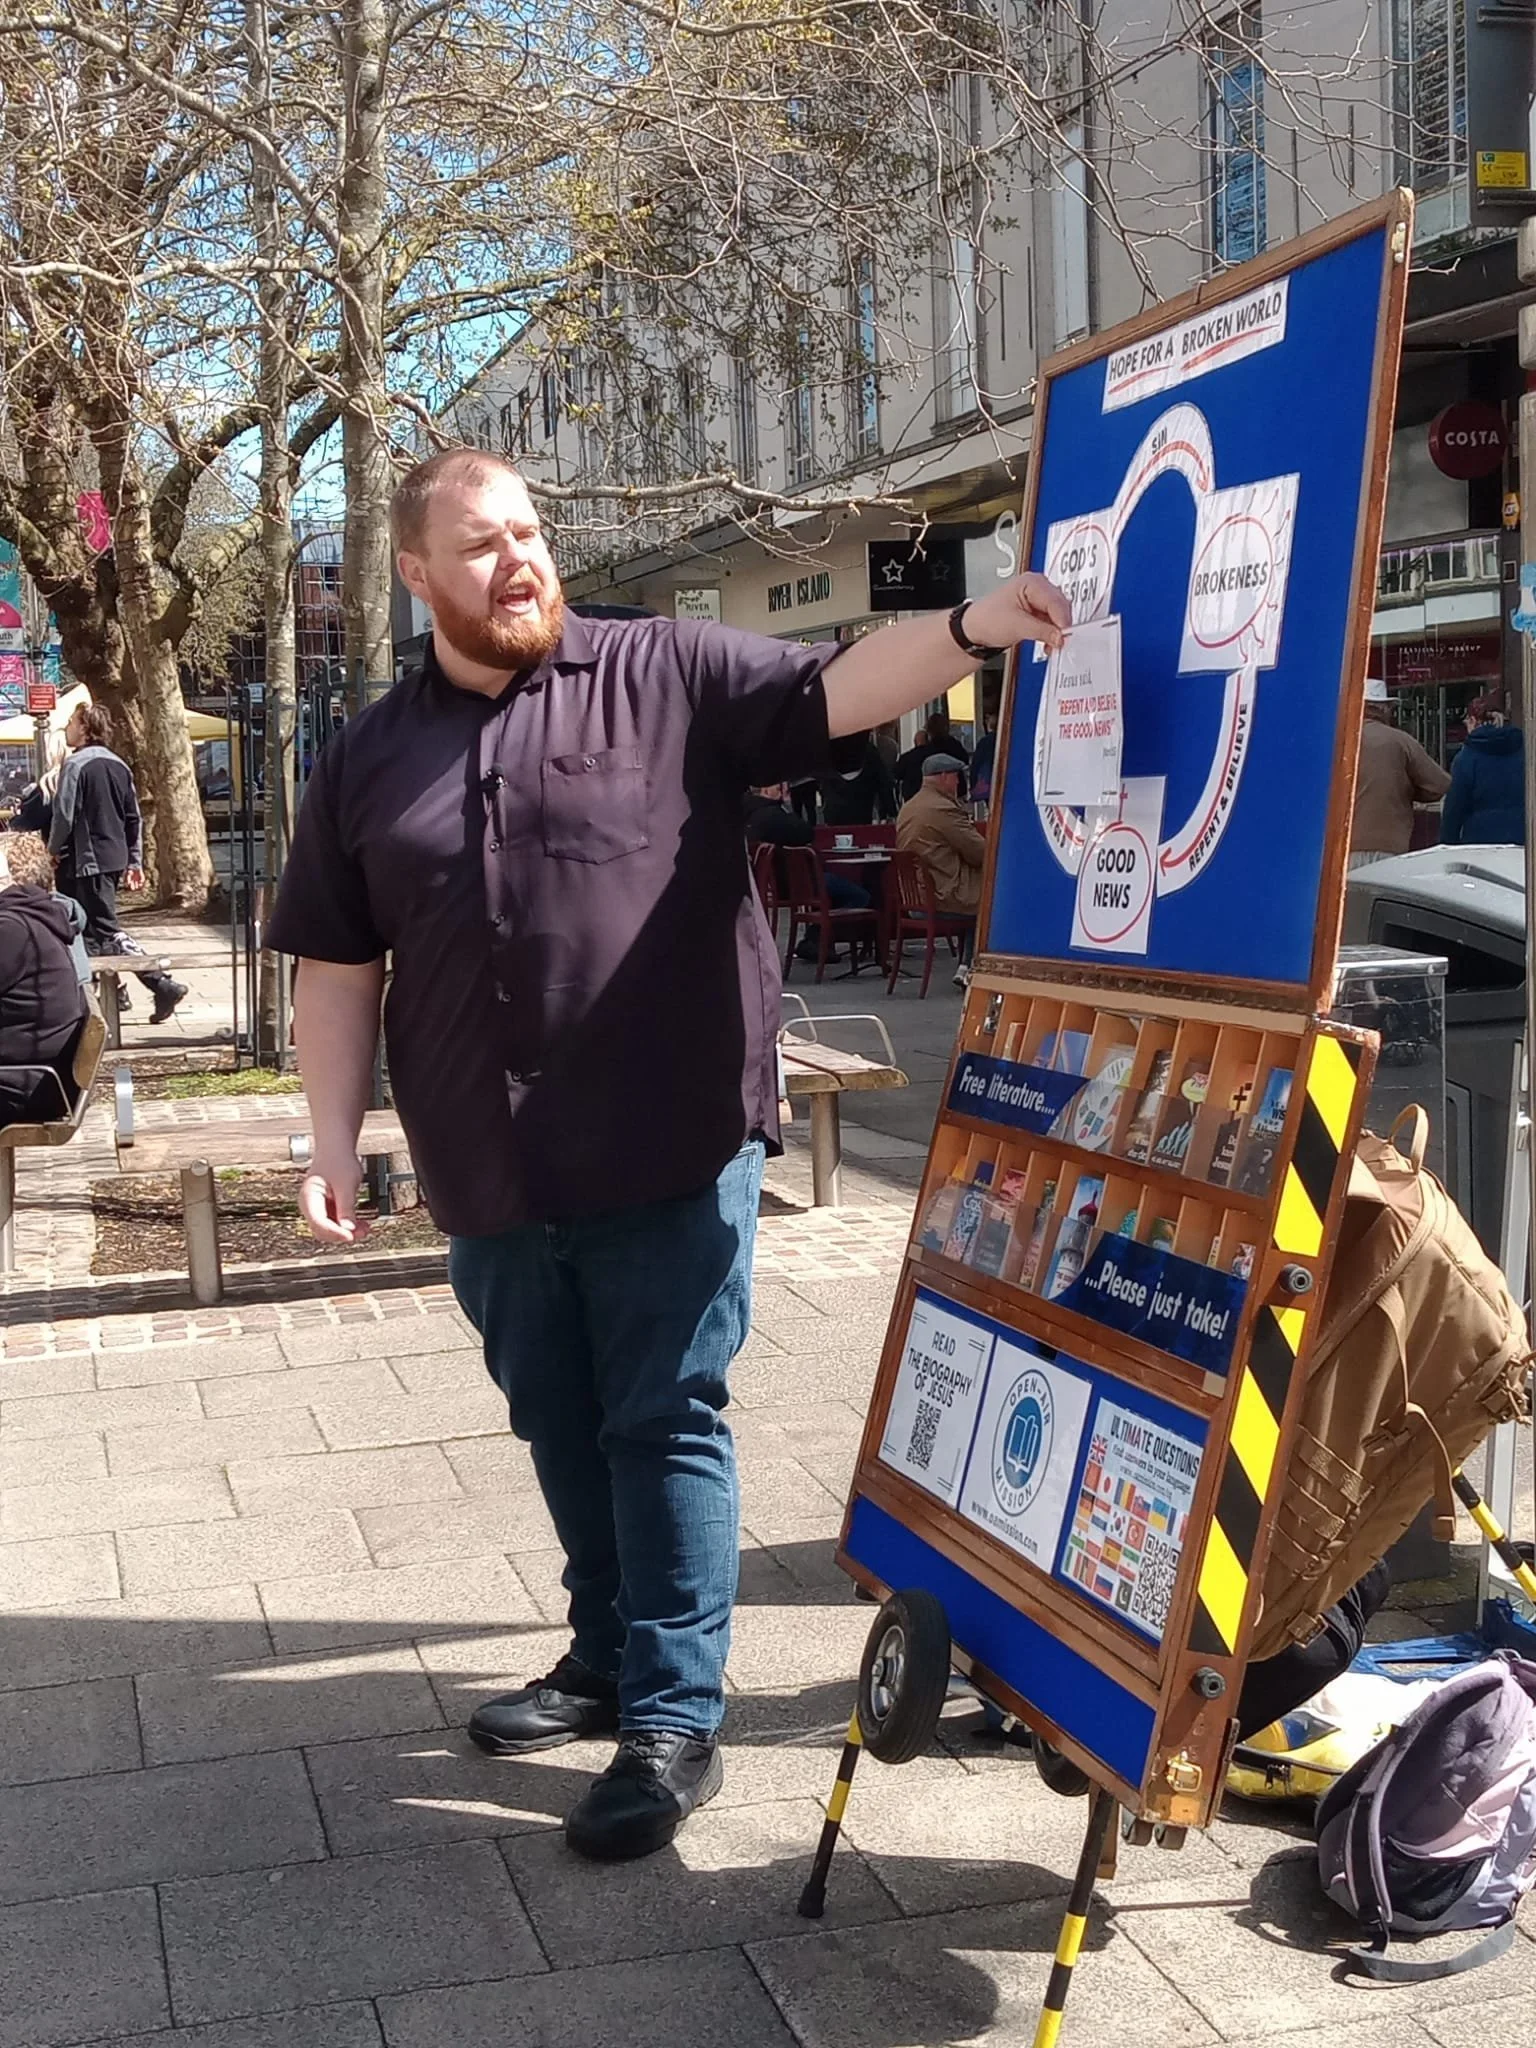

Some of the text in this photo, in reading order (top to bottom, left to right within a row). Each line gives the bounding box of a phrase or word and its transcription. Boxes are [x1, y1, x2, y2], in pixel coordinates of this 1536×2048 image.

[1109, 291, 1282, 381] HOPE FOR A BROKEN WORLD
[1152, 427, 1168, 454] SIN
[1444, 430, 1500, 447] COSTA
[1060, 544, 1097, 575] GOD'S
[768, 571, 831, 613] RIVER ISLAND
[1063, 576, 1097, 604] ESIGN
[1194, 561, 1268, 596] BROKENESS
[687, 603, 710, 612] RIVER
[1059, 673, 1078, 688] Jesus
[1059, 722, 1072, 740] THE
[1073, 720, 1093, 738] GOOD
[1188, 703, 1248, 872] REPENT & BELIEVE
[1096, 848, 1136, 874] GOOD
[1093, 882, 1132, 909] NEWS
[959, 1065, 986, 1096] Free
[1084, 1260, 1147, 1308] ...Please
[1147, 1282, 1183, 1320] just
[1184, 1297, 1230, 1340] take!
[932, 1331, 956, 1356] READ
[908, 1347, 972, 1397] THE BIOGRAPHY
[914, 1372, 954, 1408] OF JESUS
[1009, 1377, 1051, 1427] OPEN-AIR
[1110, 1414, 1200, 1479] ULTIMATE QUESTIONS
[995, 1466, 1032, 1509] MISSION
[971, 1500, 1038, 1555] www.oamission.com
